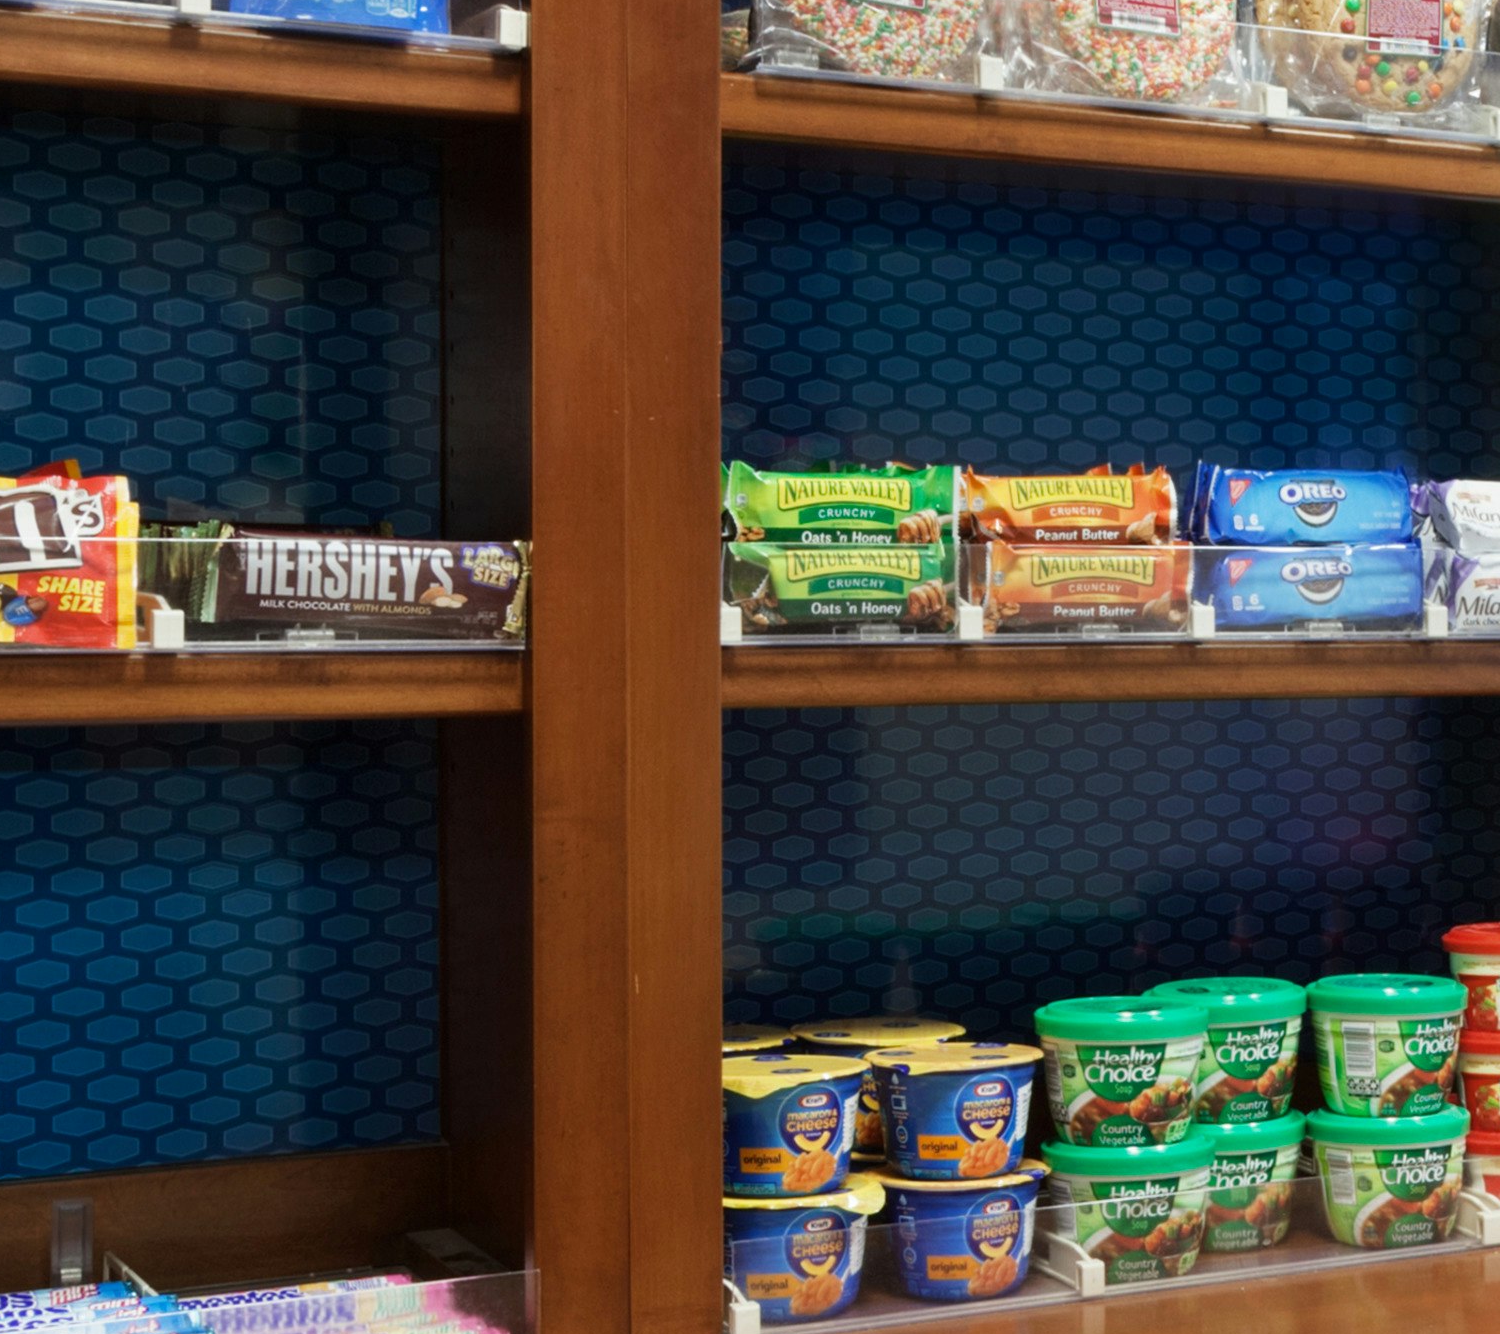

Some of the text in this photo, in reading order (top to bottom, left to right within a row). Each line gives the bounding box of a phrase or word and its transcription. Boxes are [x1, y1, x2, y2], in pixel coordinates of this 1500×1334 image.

[782, 477, 905, 501] NATURE VALLEY
[1014, 477, 1130, 502] NATURE VALLEY
[1280, 482, 1347, 504] OREO
[818, 507, 876, 520] CRUNCHY
[1035, 528, 1120, 542] Peanut Butter
[245, 540, 454, 602] HERSHEY'S
[473, 568, 508, 588] SIZE
[1282, 559, 1353, 581] OREO
[37, 575, 106, 596] SHARE
[58, 595, 105, 614] SIZE
[259, 599, 432, 616] MILK CHOCOLATE WITH ALMONDS
[811, 602, 842, 616] Oats
[861, 601, 902, 619] Honey
[1463, 617, 1483, 627] dark
[1092, 1045, 1162, 1069] Healthy
[1084, 1062, 1158, 1085] Choice
[979, 1083, 1000, 1096] Kraft
[1100, 1123, 1143, 1138] Country
[921, 1141, 959, 1155] original
[743, 1152, 782, 1168] original
[1382, 1163, 1444, 1186] Choice
